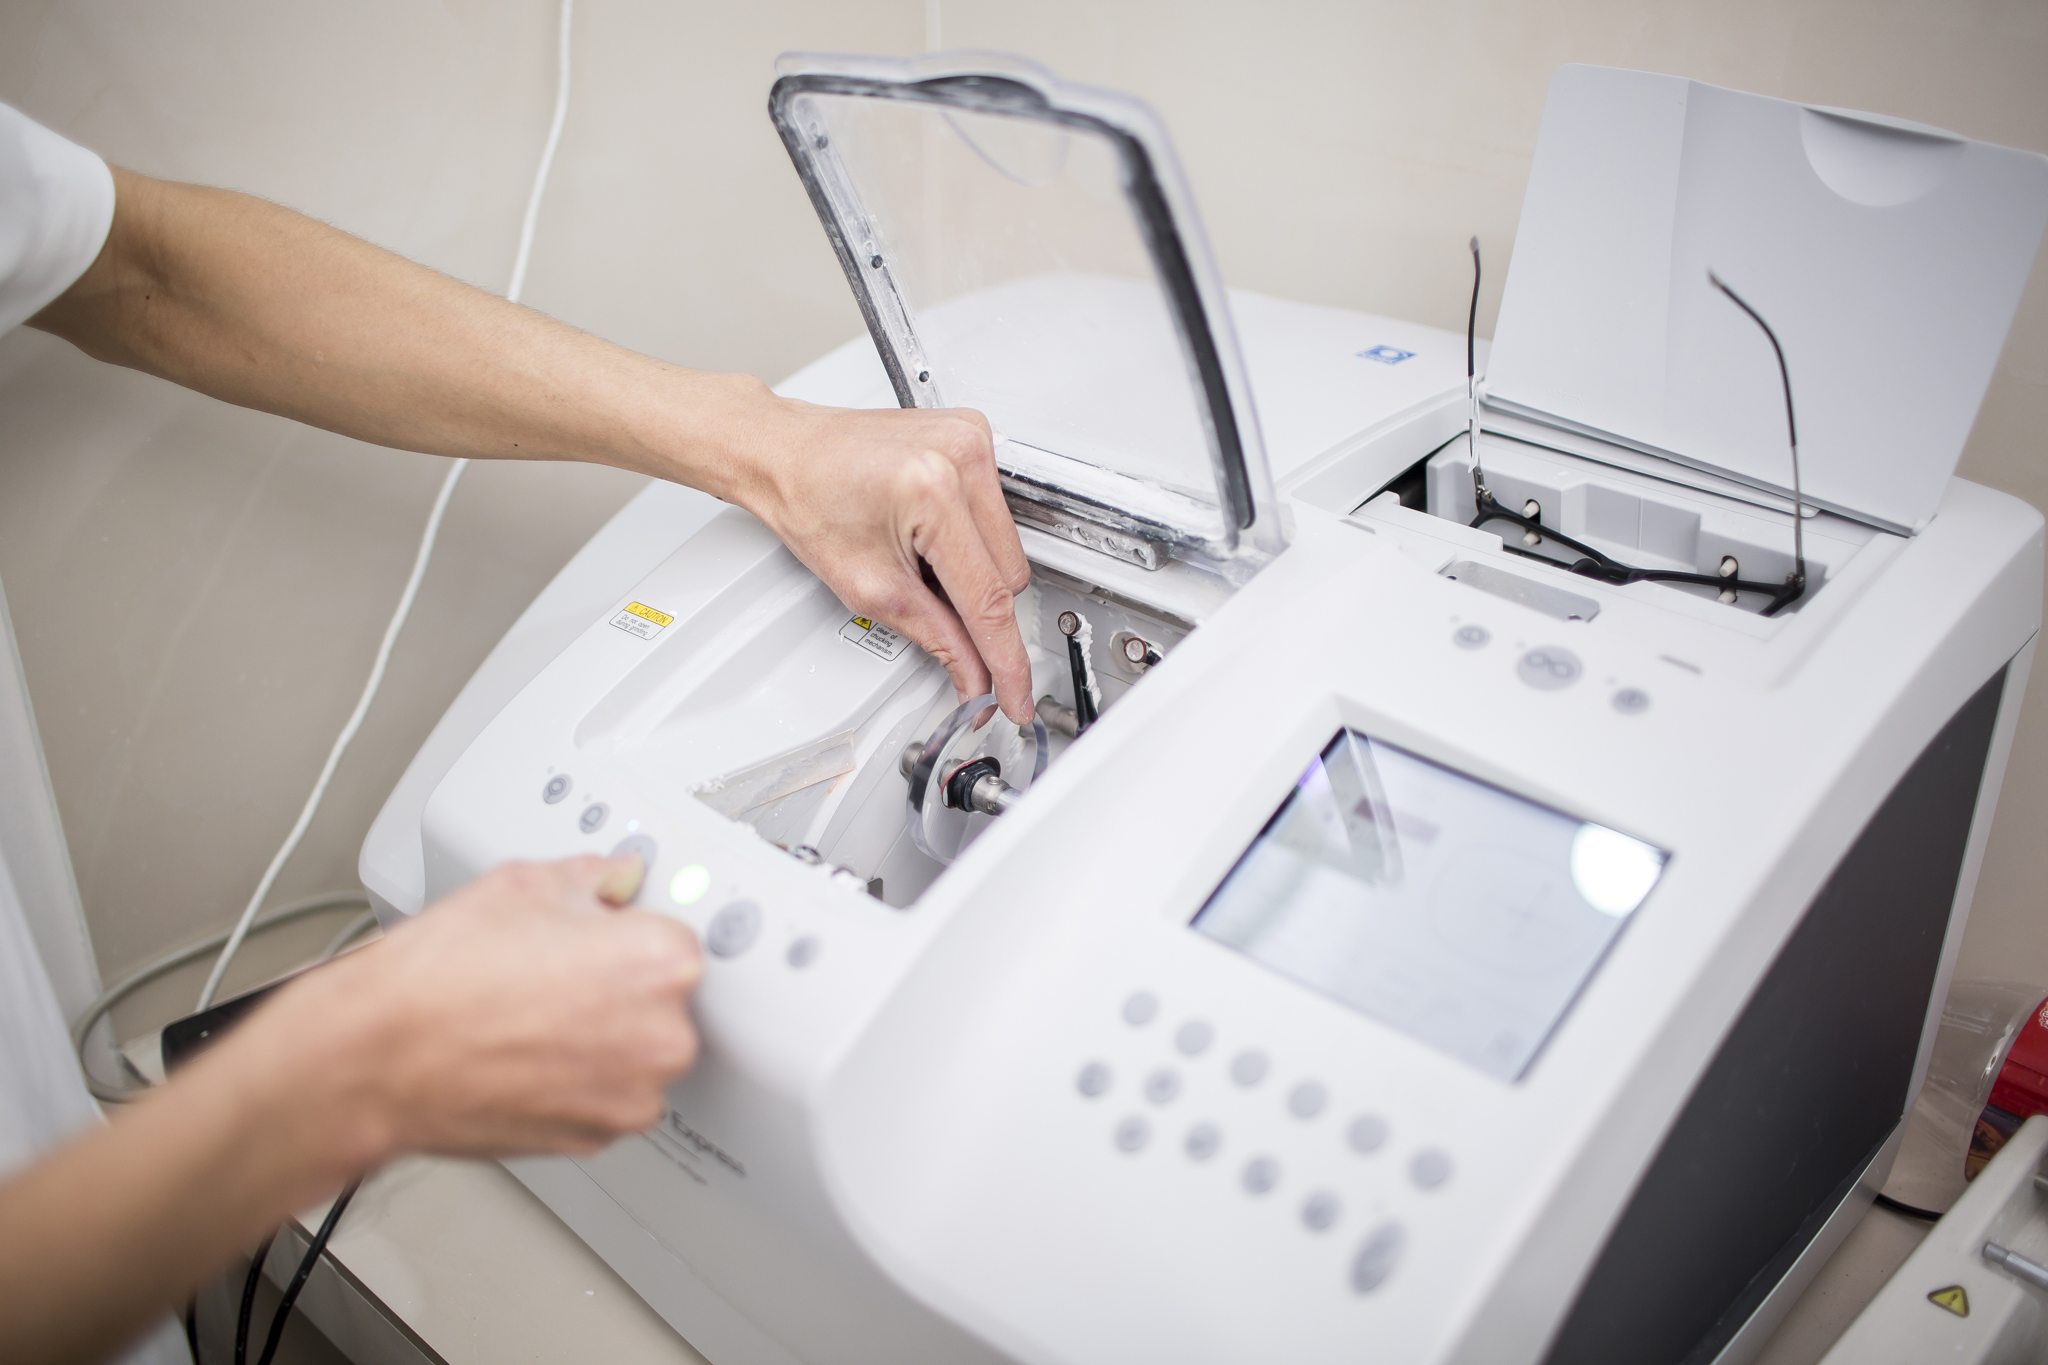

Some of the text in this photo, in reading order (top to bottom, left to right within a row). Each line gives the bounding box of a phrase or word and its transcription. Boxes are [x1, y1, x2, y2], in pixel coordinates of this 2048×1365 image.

[639, 607, 669, 624] CAUTION
[876, 626, 890, 636] clear
[870, 632, 893, 648] chucking
